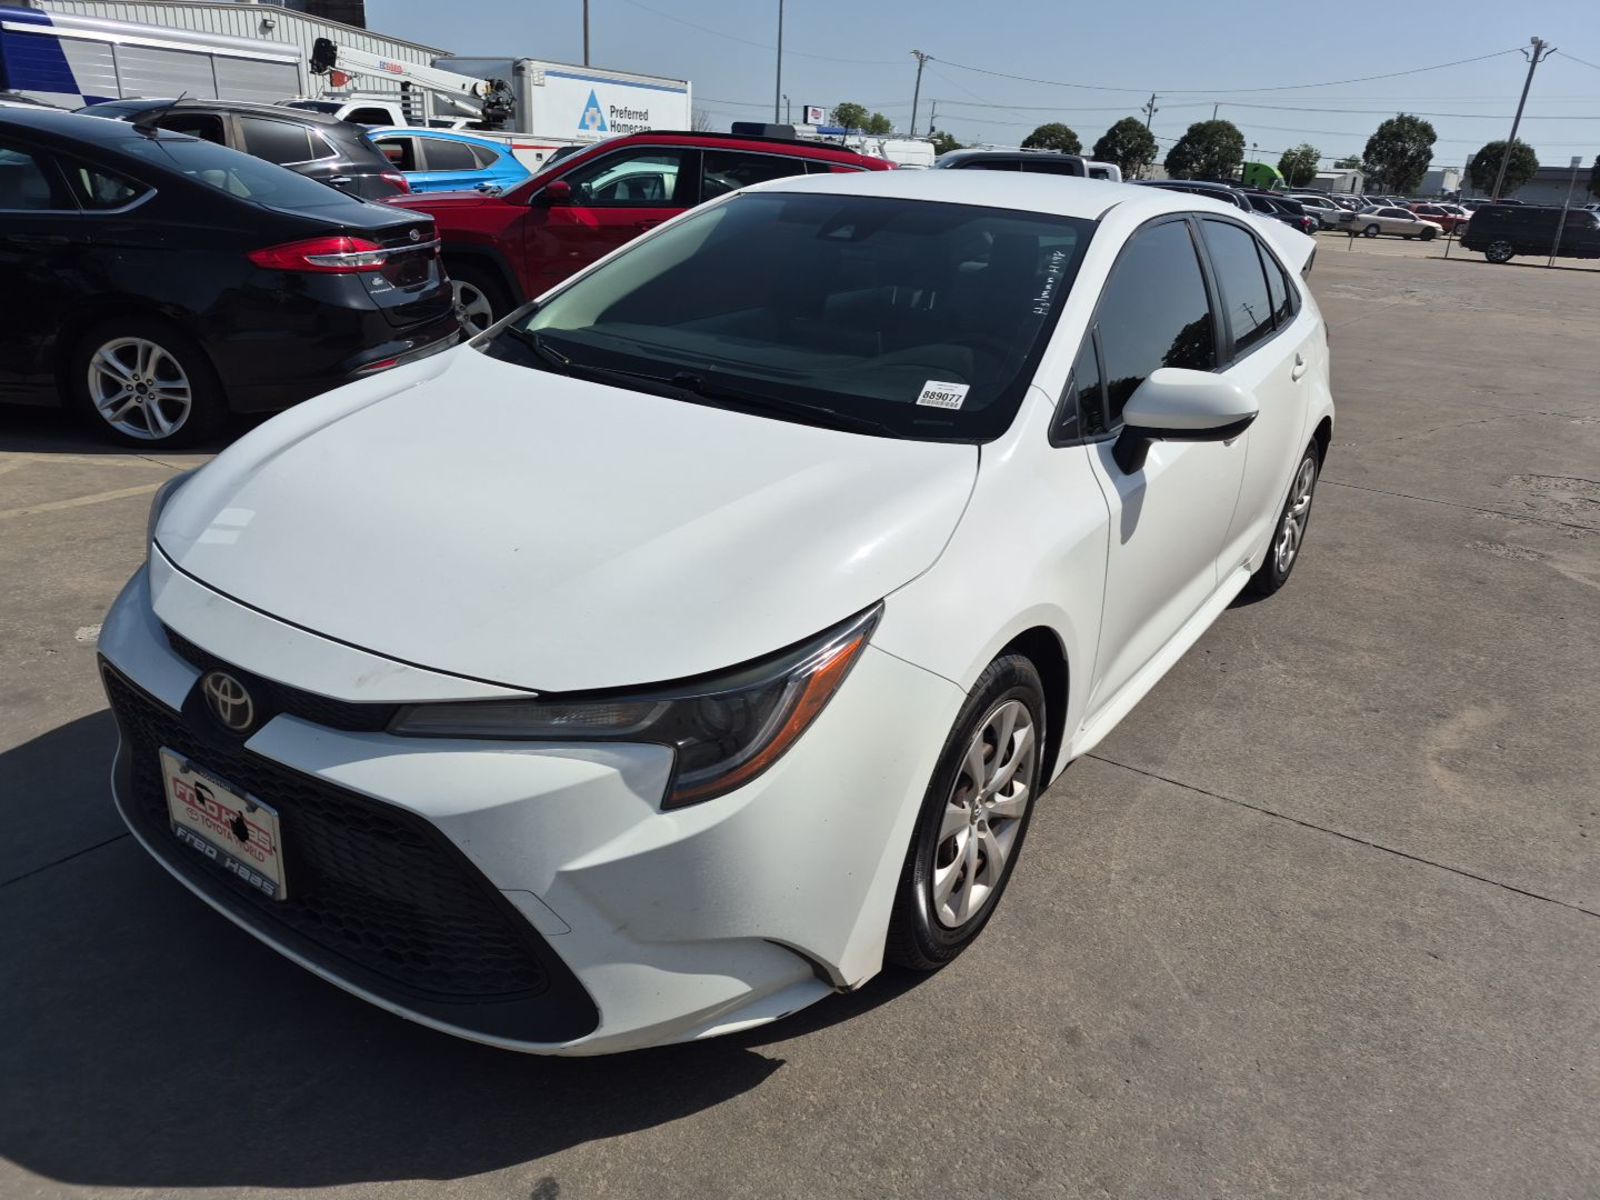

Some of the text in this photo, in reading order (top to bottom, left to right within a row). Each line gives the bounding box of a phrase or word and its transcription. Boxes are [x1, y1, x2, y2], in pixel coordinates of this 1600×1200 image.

[609, 105, 648, 121] Preferred
[922, 390, 962, 403] 889077
[201, 815, 233, 841] TOYOTA
